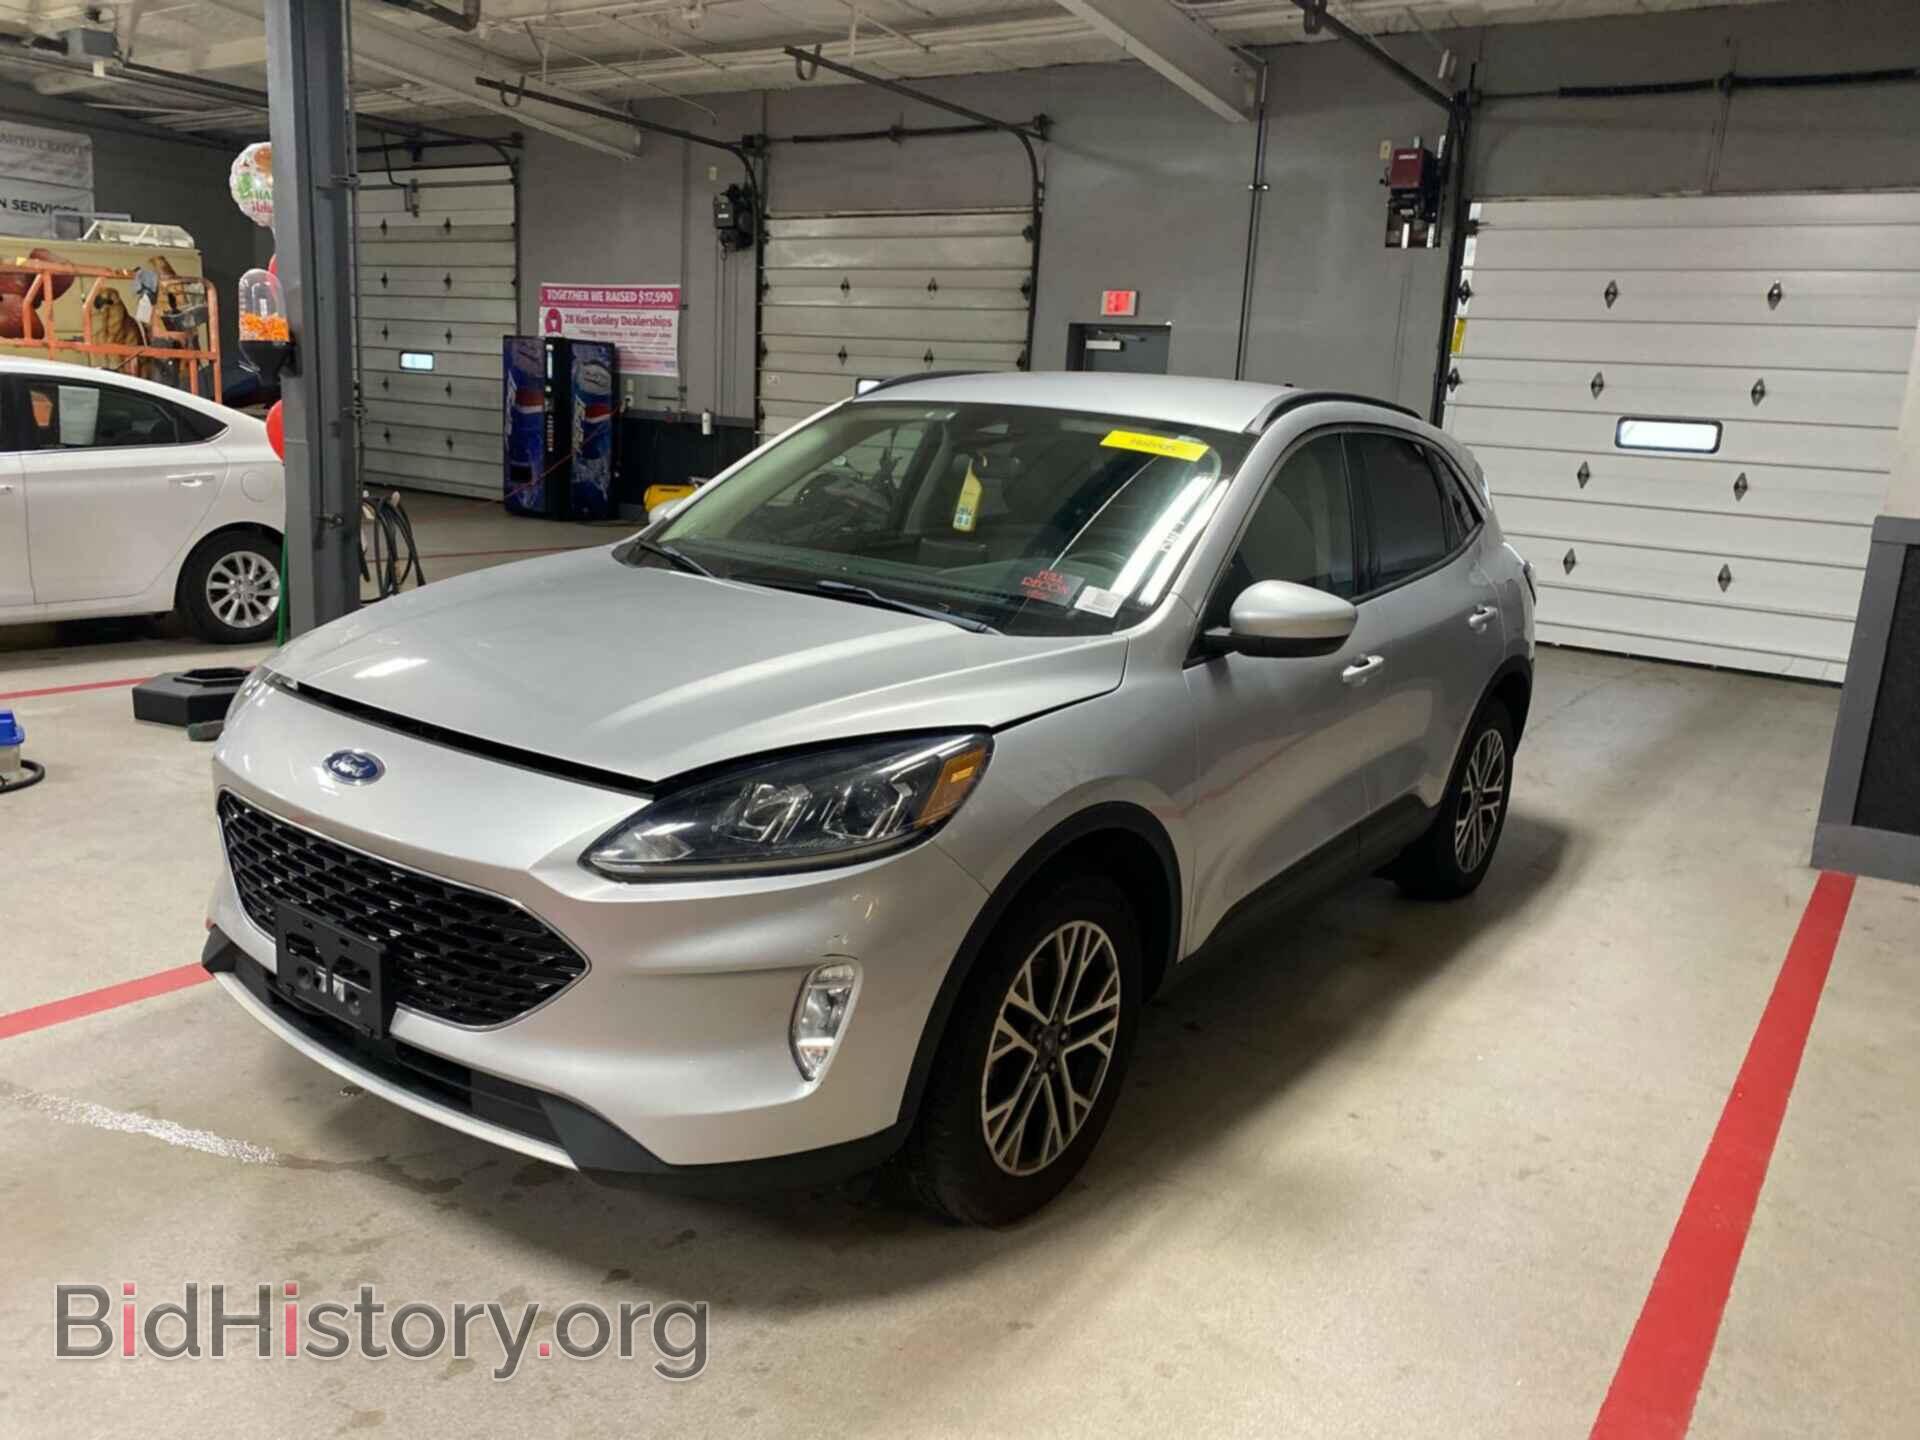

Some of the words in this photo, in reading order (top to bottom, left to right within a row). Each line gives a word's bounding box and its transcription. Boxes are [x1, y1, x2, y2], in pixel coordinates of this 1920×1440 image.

[547, 288, 590, 302] TOGETHER
[591, 290, 604, 303] WE
[605, 290, 638, 304] RAISED
[621, 316, 674, 329] Dealerships
